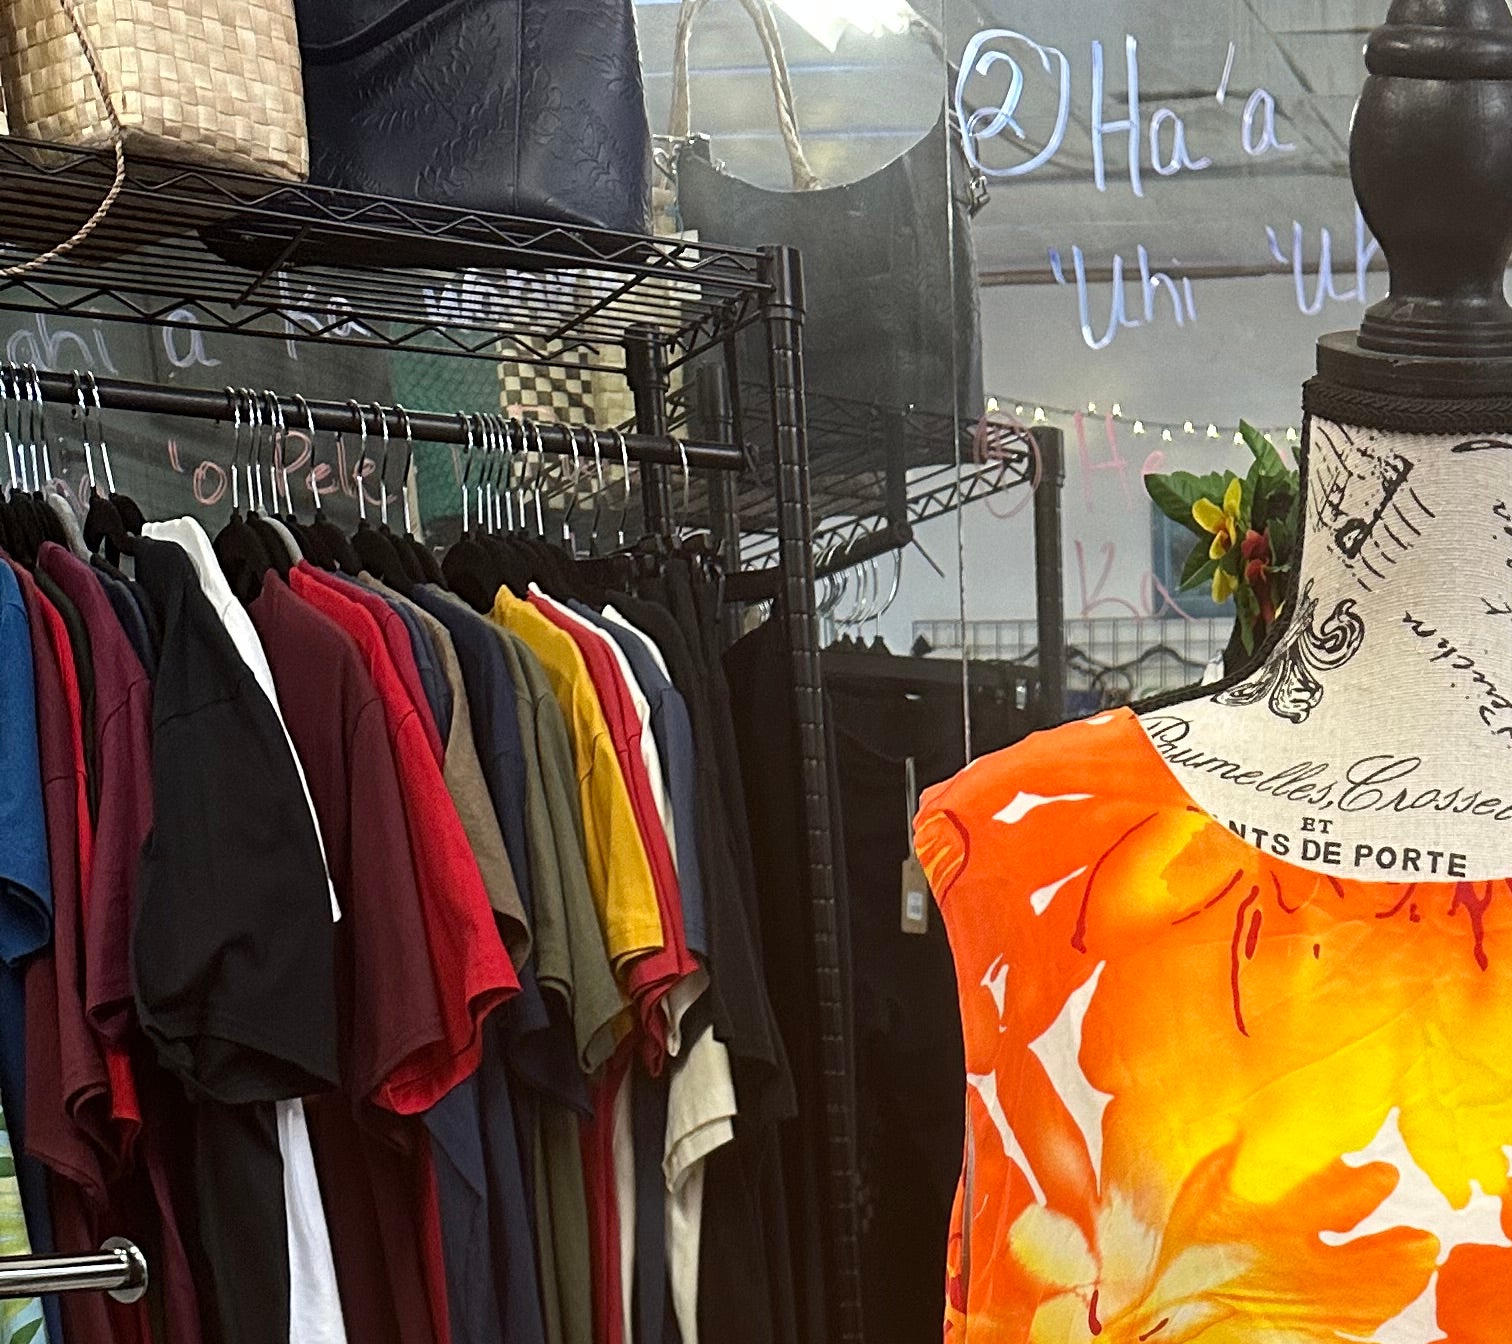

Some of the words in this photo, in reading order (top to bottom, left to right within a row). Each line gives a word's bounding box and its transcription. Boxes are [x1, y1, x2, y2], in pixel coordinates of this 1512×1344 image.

[1301, 816, 1334, 835] ET
[1226, 819, 1291, 857] NTS
[1300, 838, 1343, 866] DE
[1353, 843, 1468, 879] PORTE
